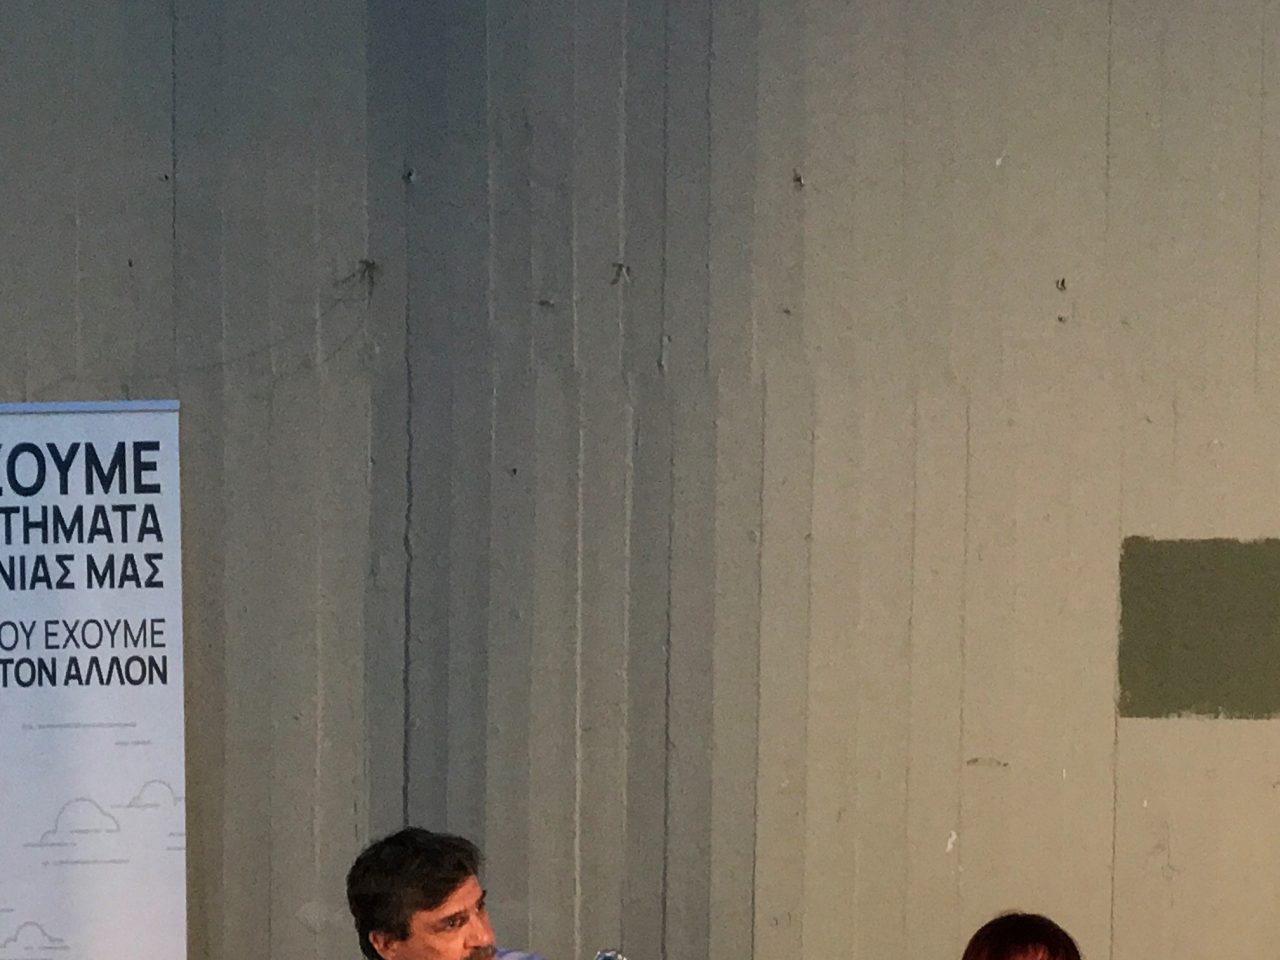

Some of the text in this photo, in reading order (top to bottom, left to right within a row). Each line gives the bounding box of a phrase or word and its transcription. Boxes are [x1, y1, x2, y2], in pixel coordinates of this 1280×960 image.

[0, 441, 161, 497] ΟΥΜΕ
[86, 553, 164, 589] ΜΑΣ
[45, 618, 166, 649] ΕΧΟΥΜΕ
[0, 655, 168, 688] ΤΟΝ ΑΛΛΟΝ
